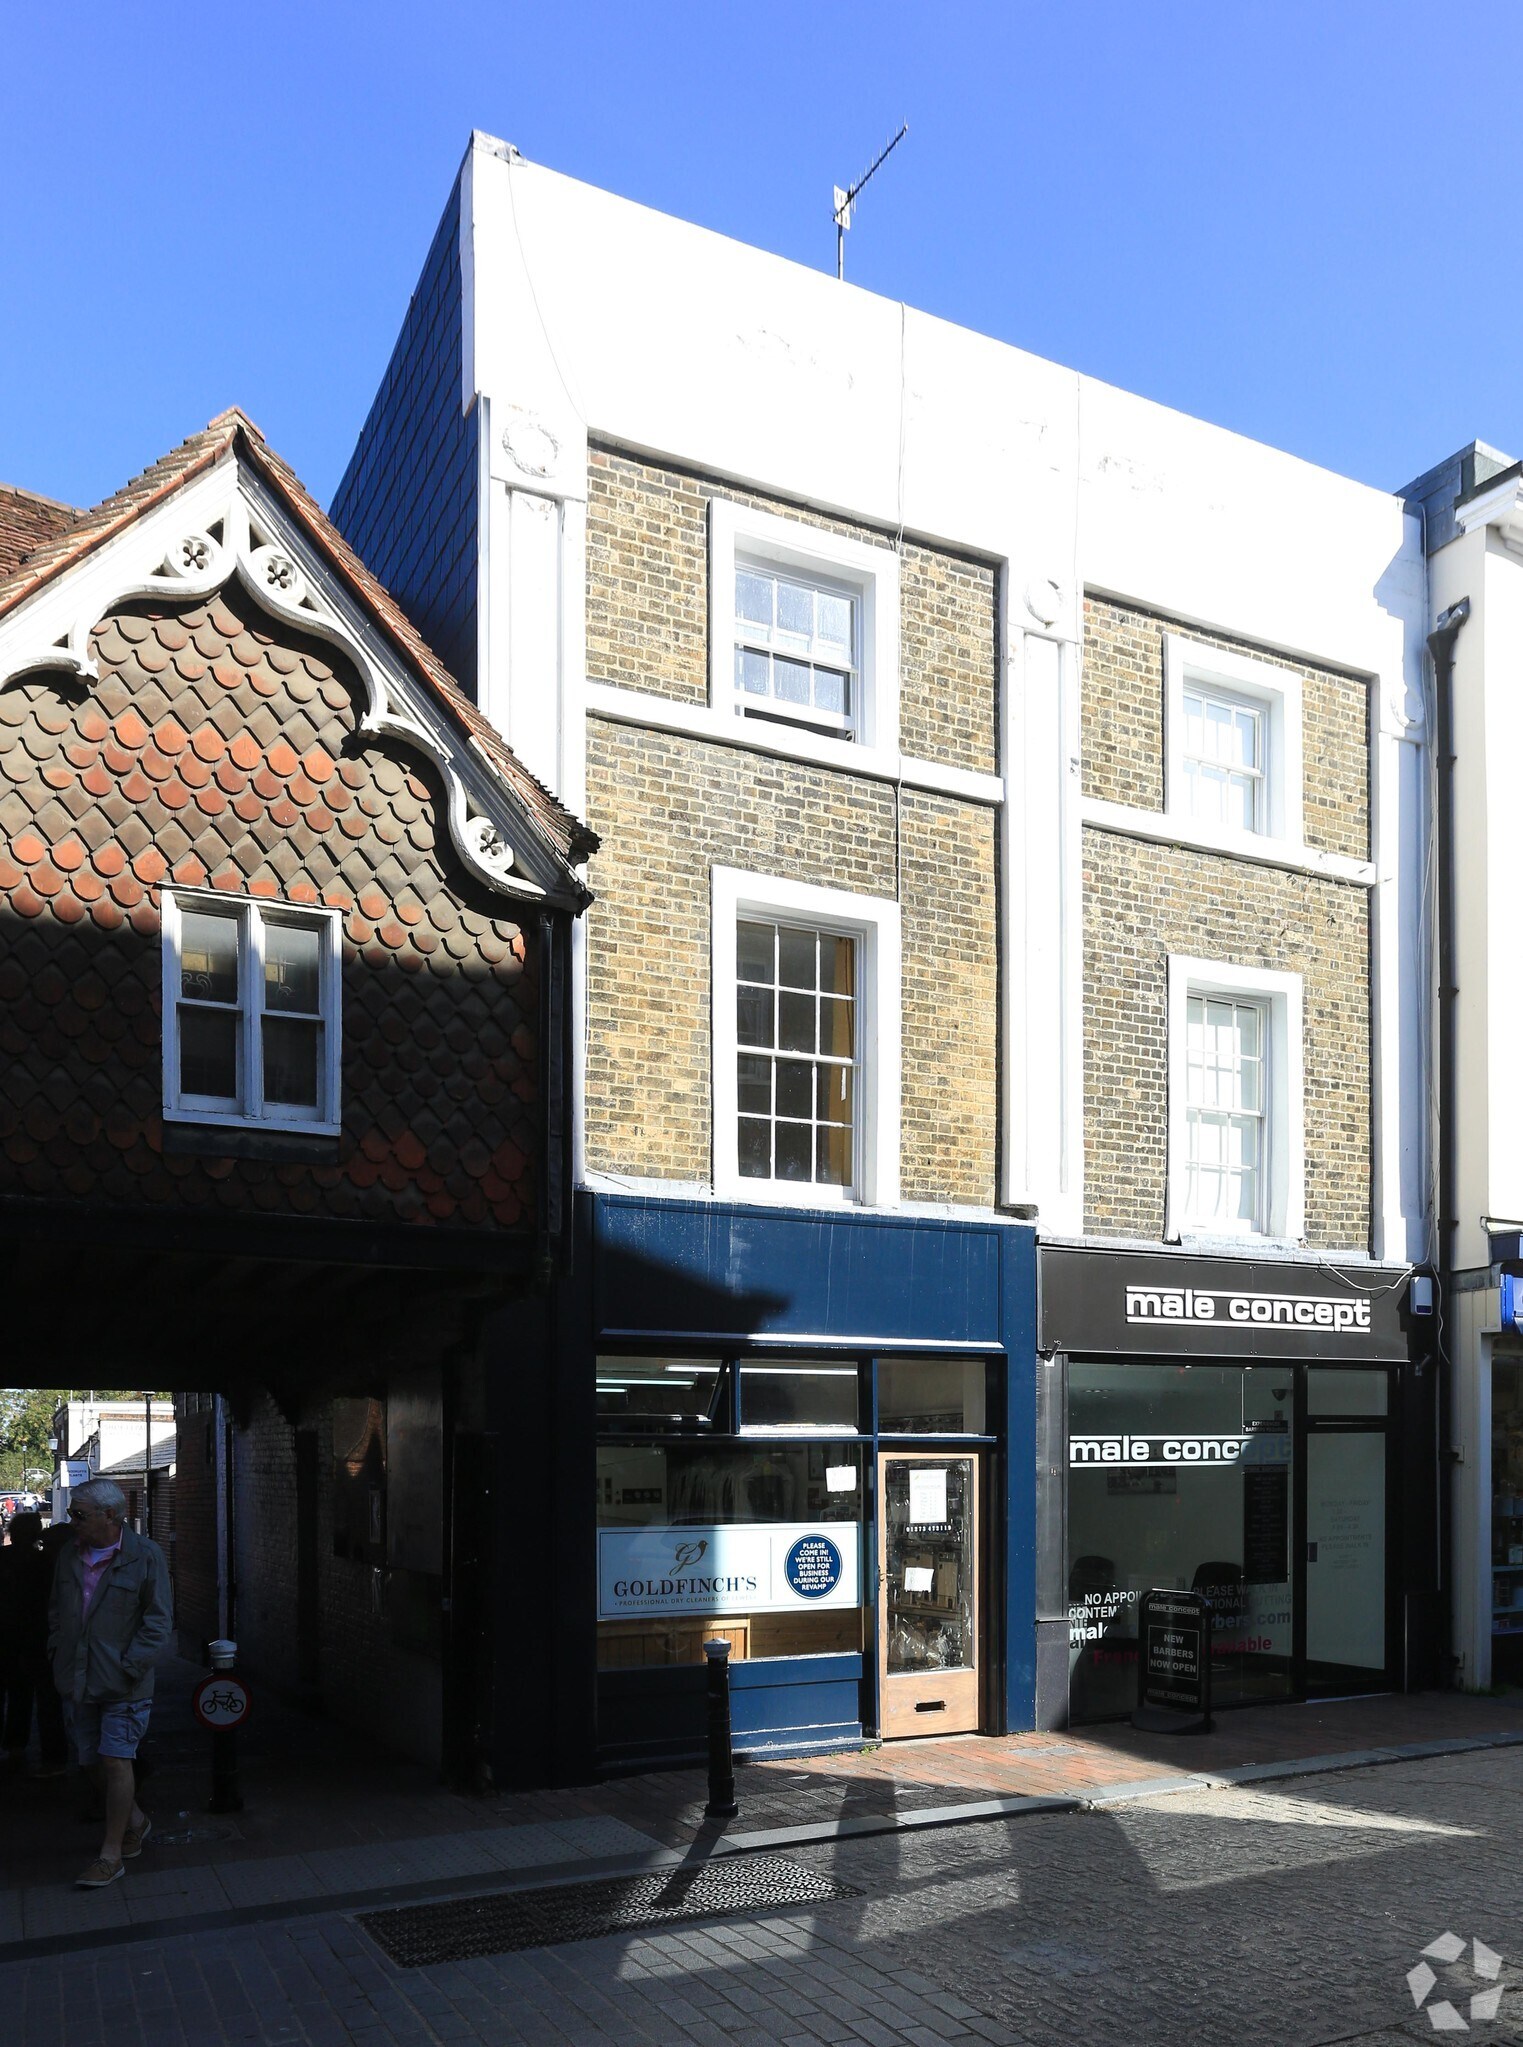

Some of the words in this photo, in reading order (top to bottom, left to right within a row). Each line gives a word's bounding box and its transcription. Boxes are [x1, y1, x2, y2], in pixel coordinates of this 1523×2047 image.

[1126, 1289, 1215, 1319] male
[1228, 1299, 1371, 1332] concept
[1070, 1435, 1150, 1461] male
[613, 1576, 757, 1597] GOLDFINCH'S
[619, 1599, 668, 1607] PROFESSIONAL
[686, 1596, 719, 1604] CLEANERS
[1084, 1593, 1102, 1606] NO
[1104, 1590, 1142, 1604] APPOI
[1068, 1605, 1119, 1620] CONTEM
[1163, 1633, 1184, 1644] NEW
[1153, 1646, 1194, 1659] BARBERS
[1150, 1658, 1171, 1669] NOW
[1172, 1662, 1197, 1673] OPEN
